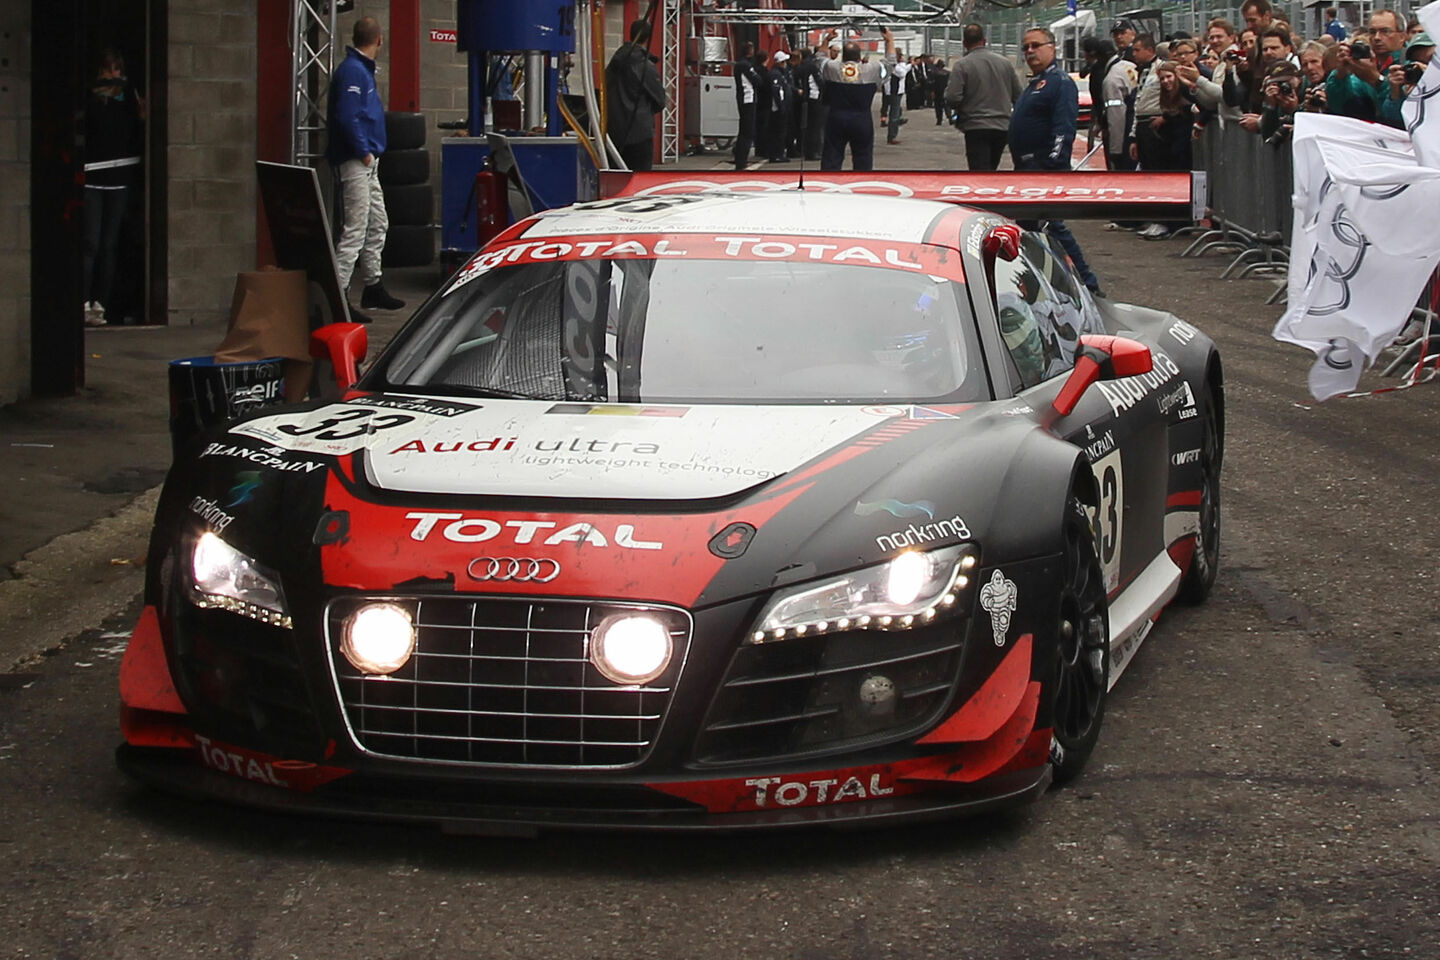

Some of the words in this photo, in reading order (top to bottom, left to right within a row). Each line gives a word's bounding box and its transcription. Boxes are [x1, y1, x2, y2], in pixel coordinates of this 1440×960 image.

[431, 30, 457, 41] TOTA
[941, 185, 1125, 197] Belgian
[508, 240, 688, 262] TOTAL
[715, 237, 922, 269] TOTAL
[250, 379, 279, 398] elf
[348, 398, 467, 417] BLANCPAIN
[1178, 408, 1198, 420] Lease
[277, 408, 416, 440] 33
[199, 442, 325, 473] BLANCPAIN
[389, 436, 519, 455] Audi
[535, 438, 660, 455] ultra
[525, 454, 650, 469] lightweight
[659, 460, 778, 479] technology
[405, 512, 663, 550] TOTAL
[876, 515, 971, 552] norkring
[195, 734, 288, 787] TOTAL
[745, 773, 894, 808] TOTAL
